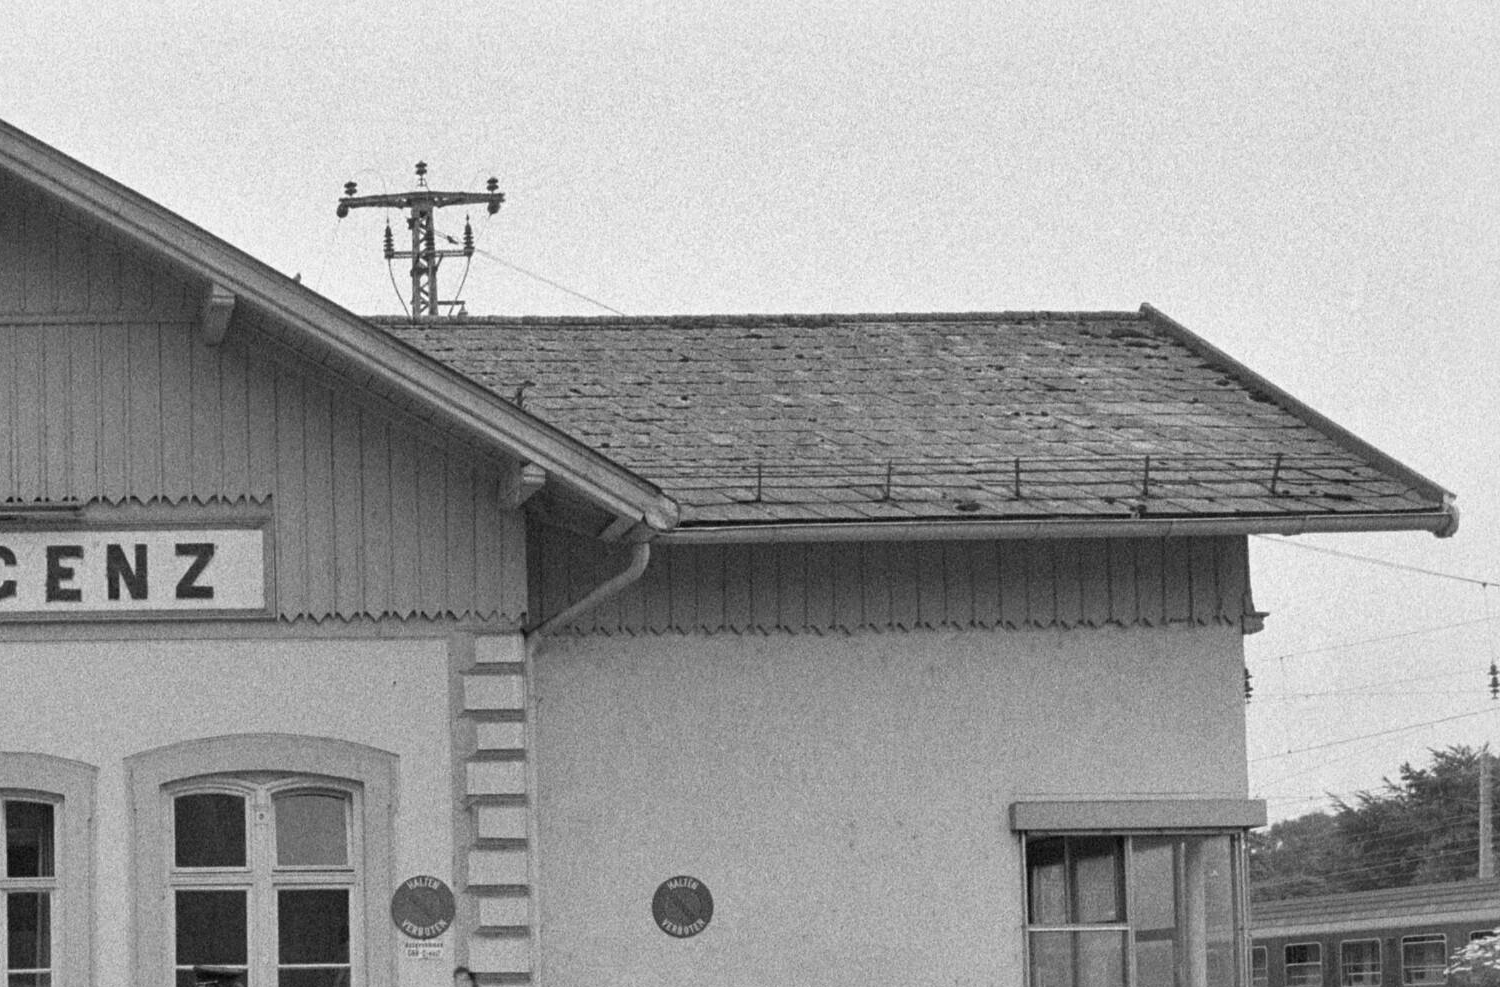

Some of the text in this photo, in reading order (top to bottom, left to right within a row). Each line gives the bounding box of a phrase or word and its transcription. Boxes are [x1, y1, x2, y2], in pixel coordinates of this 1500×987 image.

[406, 877, 440, 890] HALTEN
[667, 878, 699, 890] HALTEN
[402, 919, 448, 937] VERBOTEN
[662, 918, 706, 936] VERBOTEN
